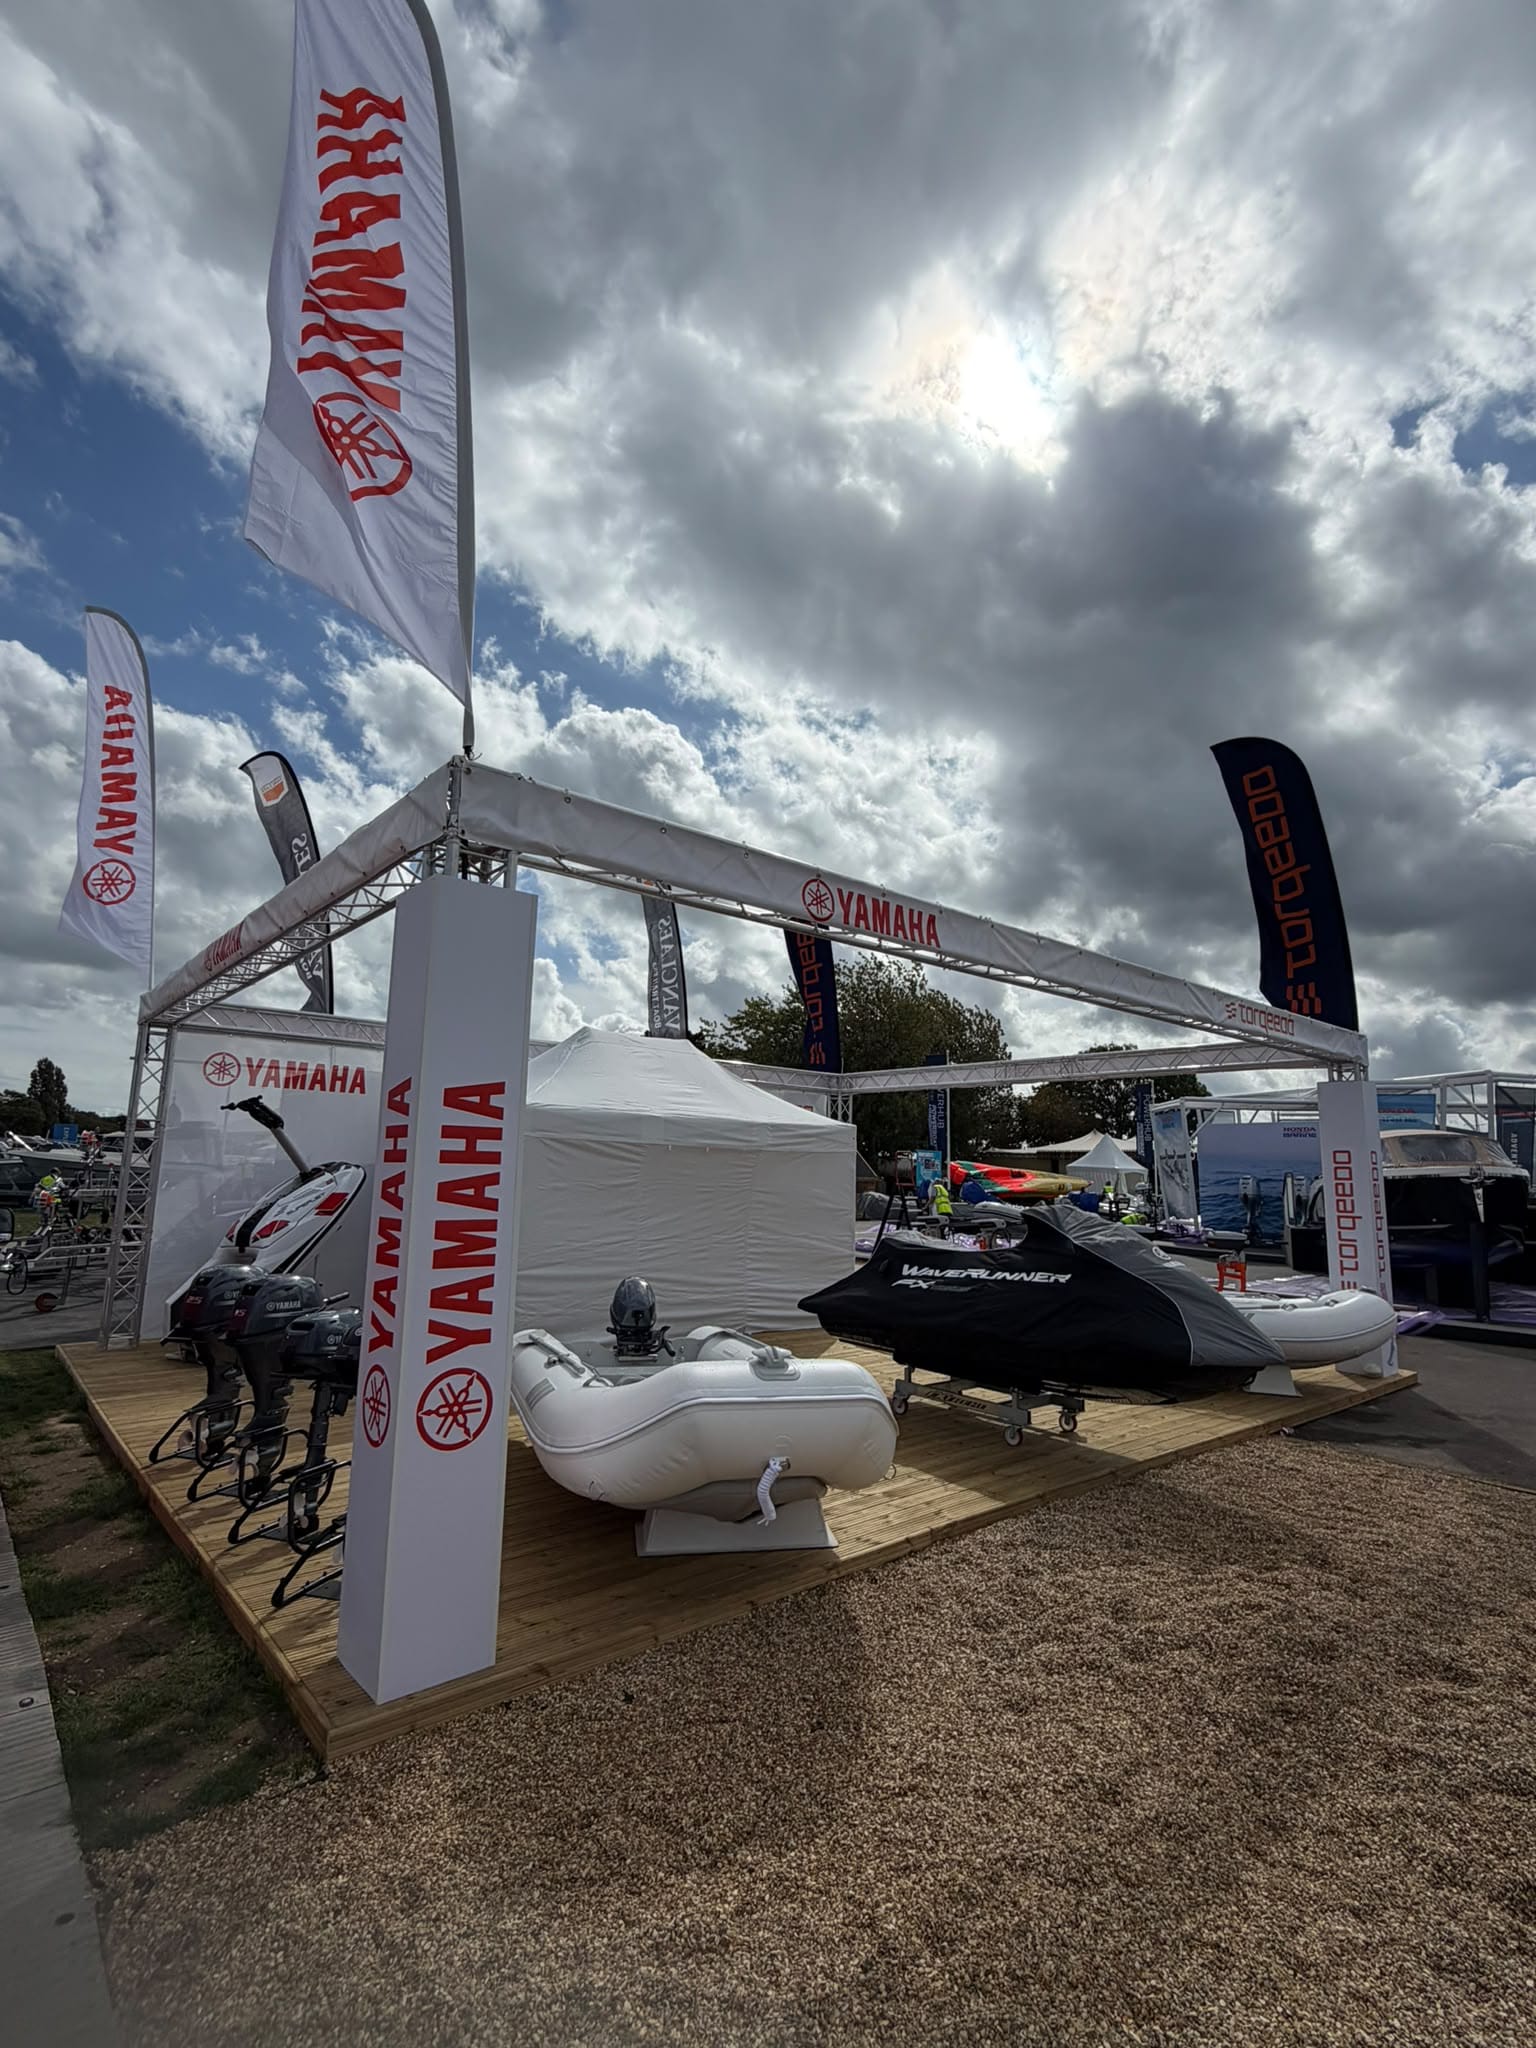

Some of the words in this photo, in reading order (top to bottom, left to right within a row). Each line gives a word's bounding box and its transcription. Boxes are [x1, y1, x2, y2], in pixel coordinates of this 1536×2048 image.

[837, 887, 941, 949] YAMAHA
[796, 932, 824, 1033] torqee
[245, 1056, 366, 1095] YAMAHA
[368, 1076, 412, 1353] YAMAHA
[426, 1081, 506, 1365] YAMAHA
[275, 1301, 301, 1310] YAMAHA
